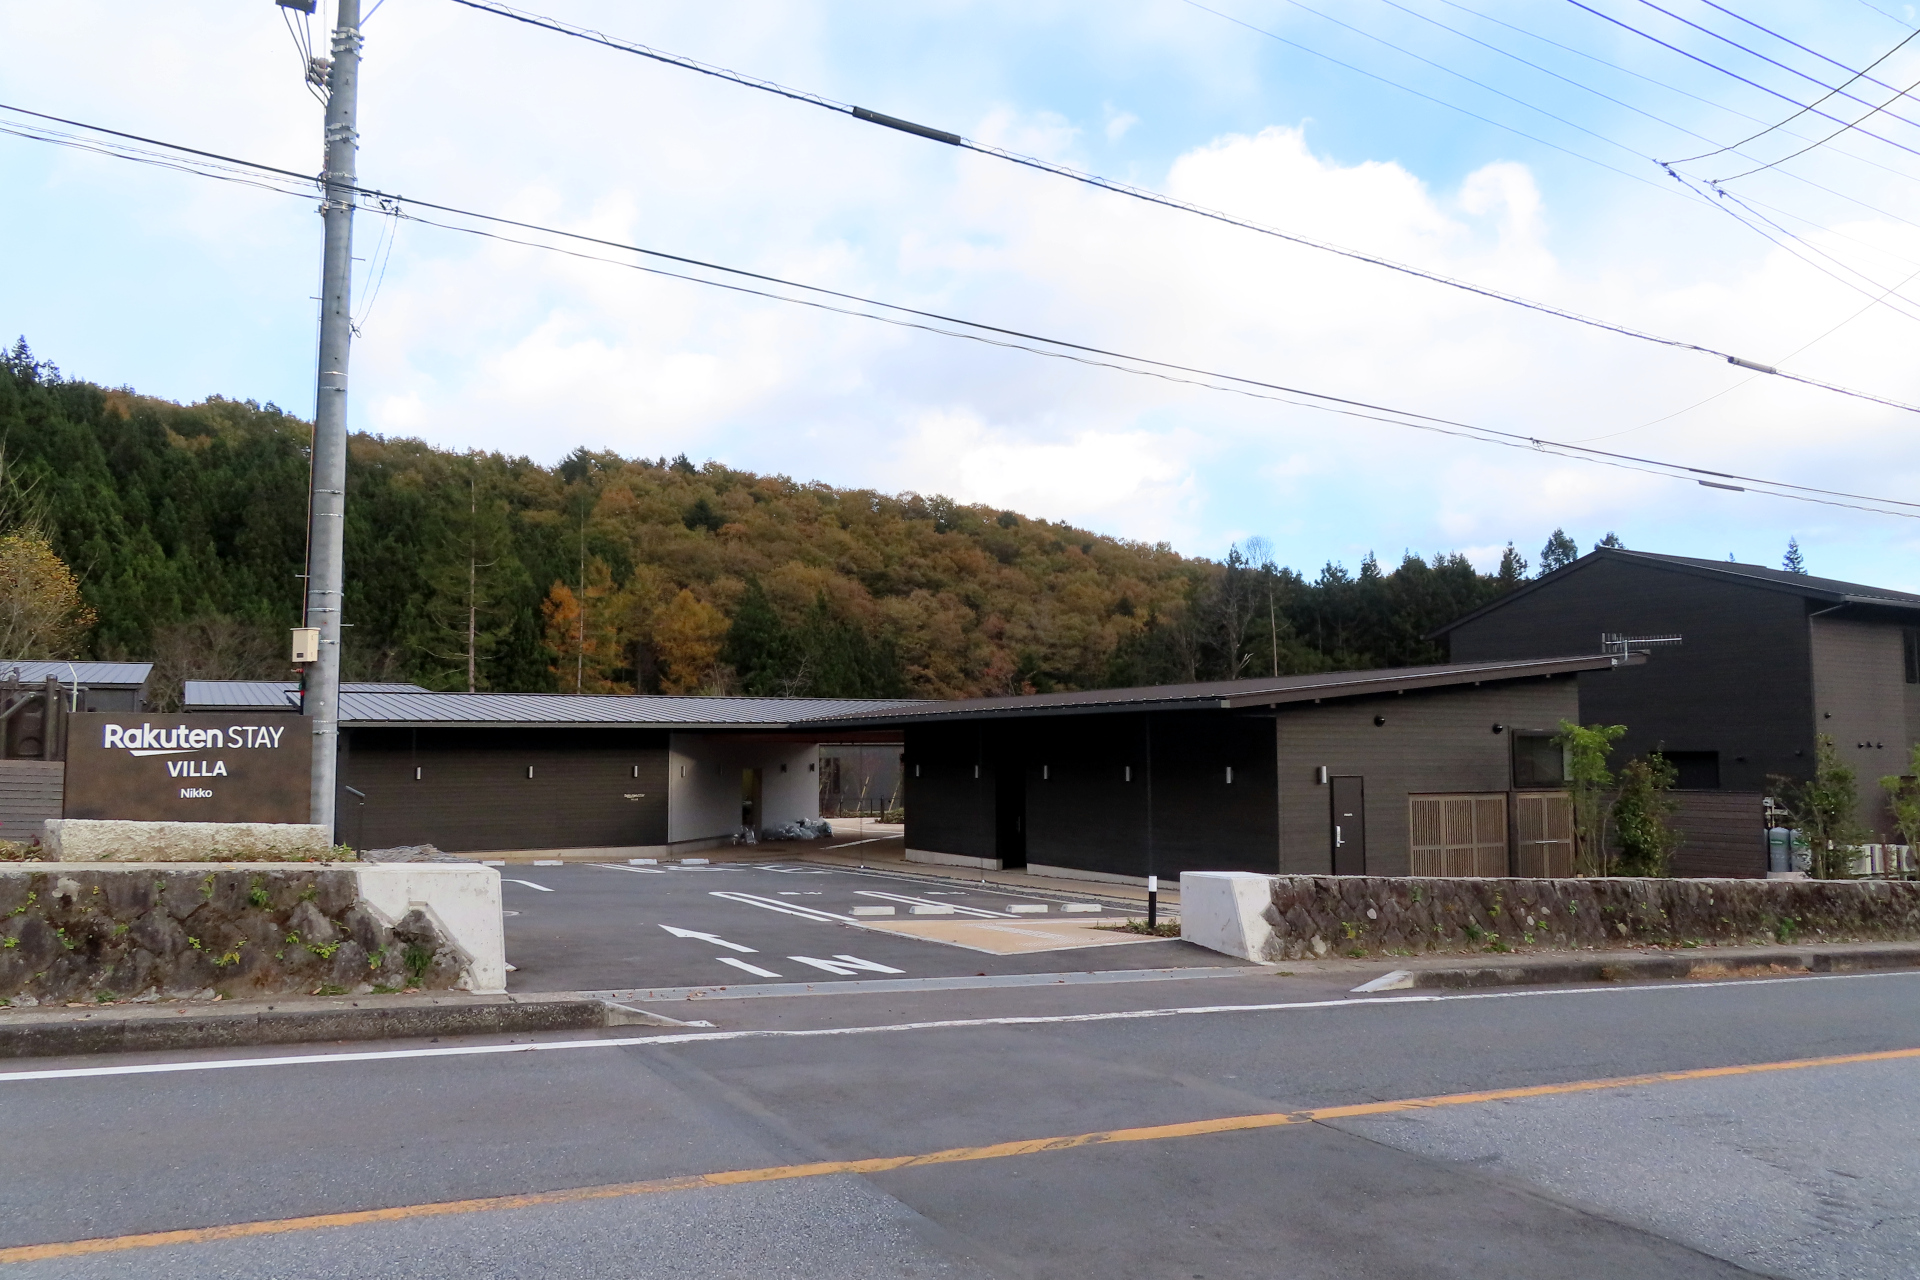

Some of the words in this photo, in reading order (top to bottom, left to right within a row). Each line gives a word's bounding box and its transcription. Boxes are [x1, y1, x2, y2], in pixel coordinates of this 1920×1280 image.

[104, 722, 224, 750] Rakuten
[227, 726, 285, 749] STAY
[167, 760, 228, 777] VILLA
[180, 787, 213, 799] Nikko
[715, 954, 907, 978] IN
